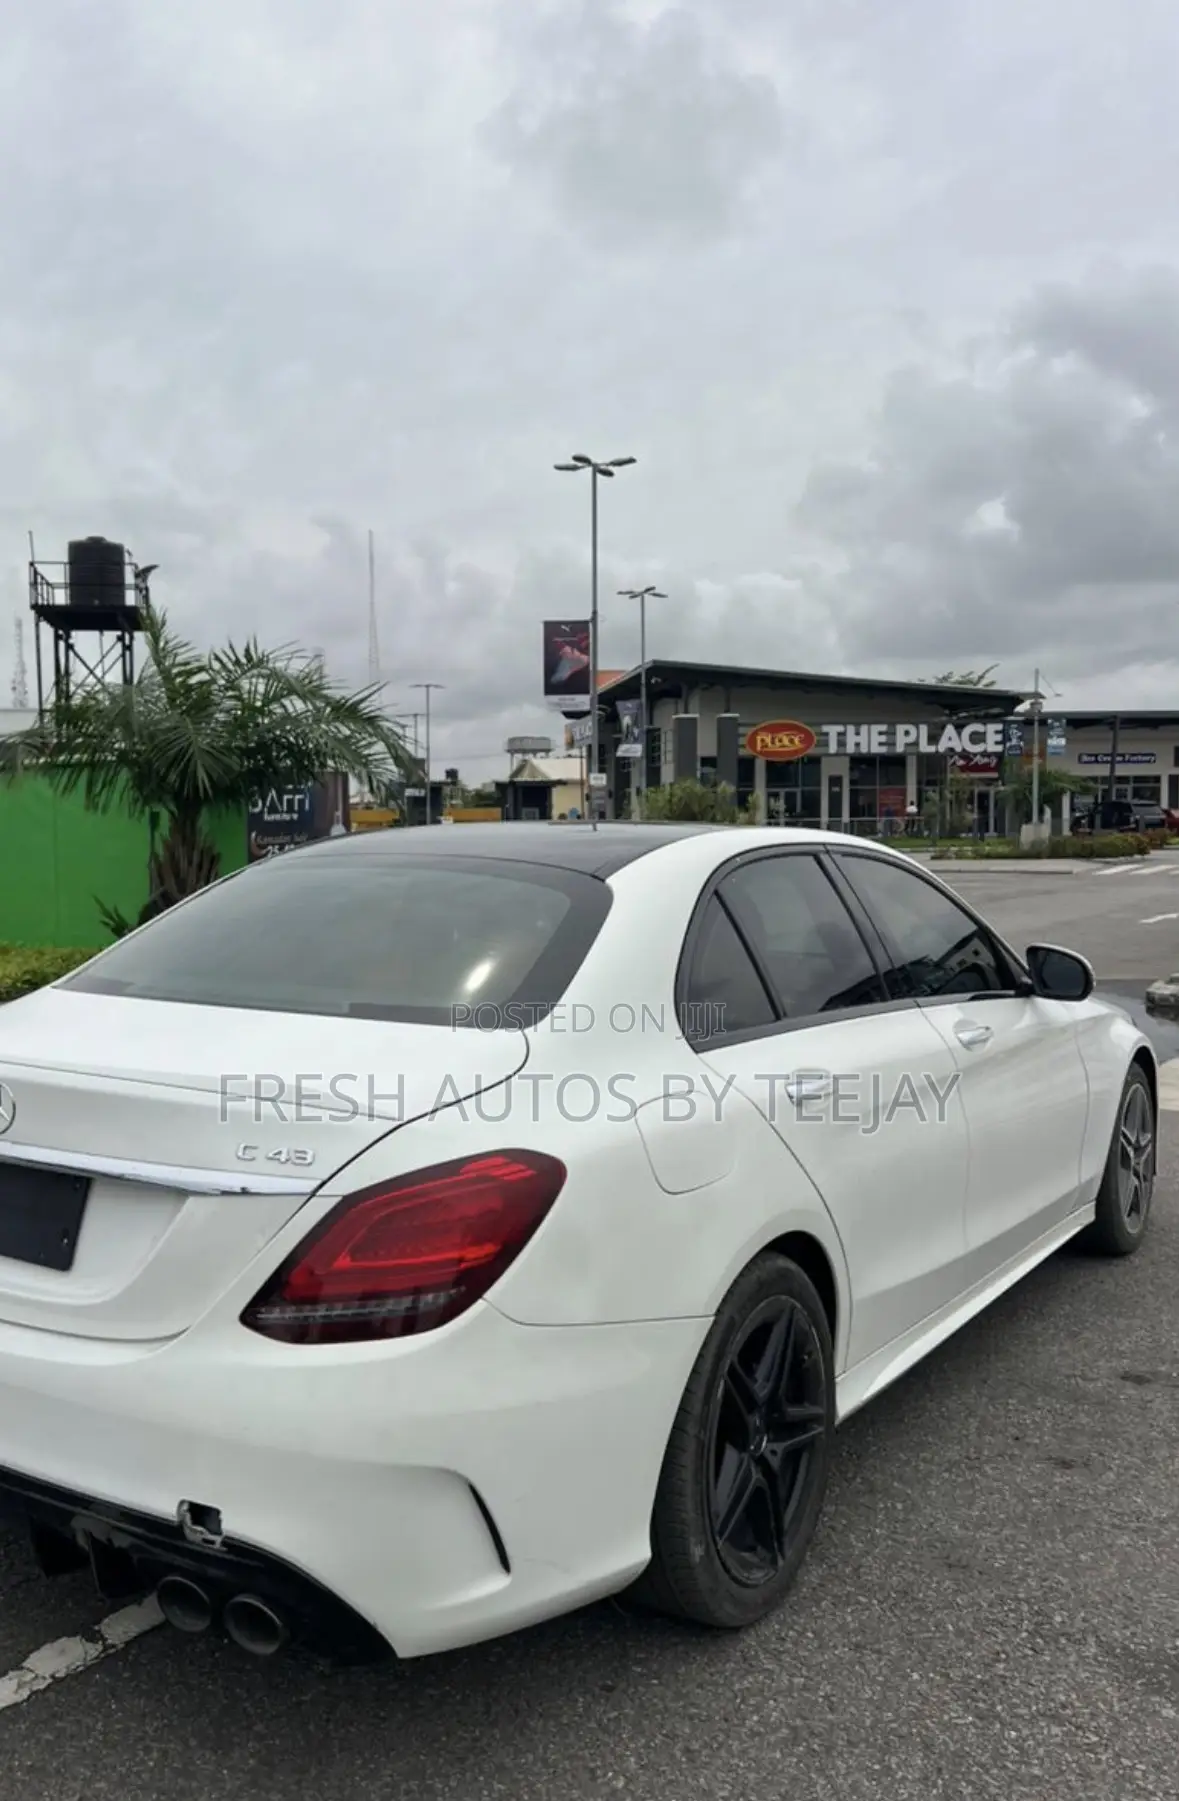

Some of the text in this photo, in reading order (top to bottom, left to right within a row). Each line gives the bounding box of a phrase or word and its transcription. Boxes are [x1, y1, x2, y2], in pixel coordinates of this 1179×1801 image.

[822, 724, 888, 753] THE
[896, 723, 1004, 753] PLACE
[236, 1141, 316, 1166] C 43
